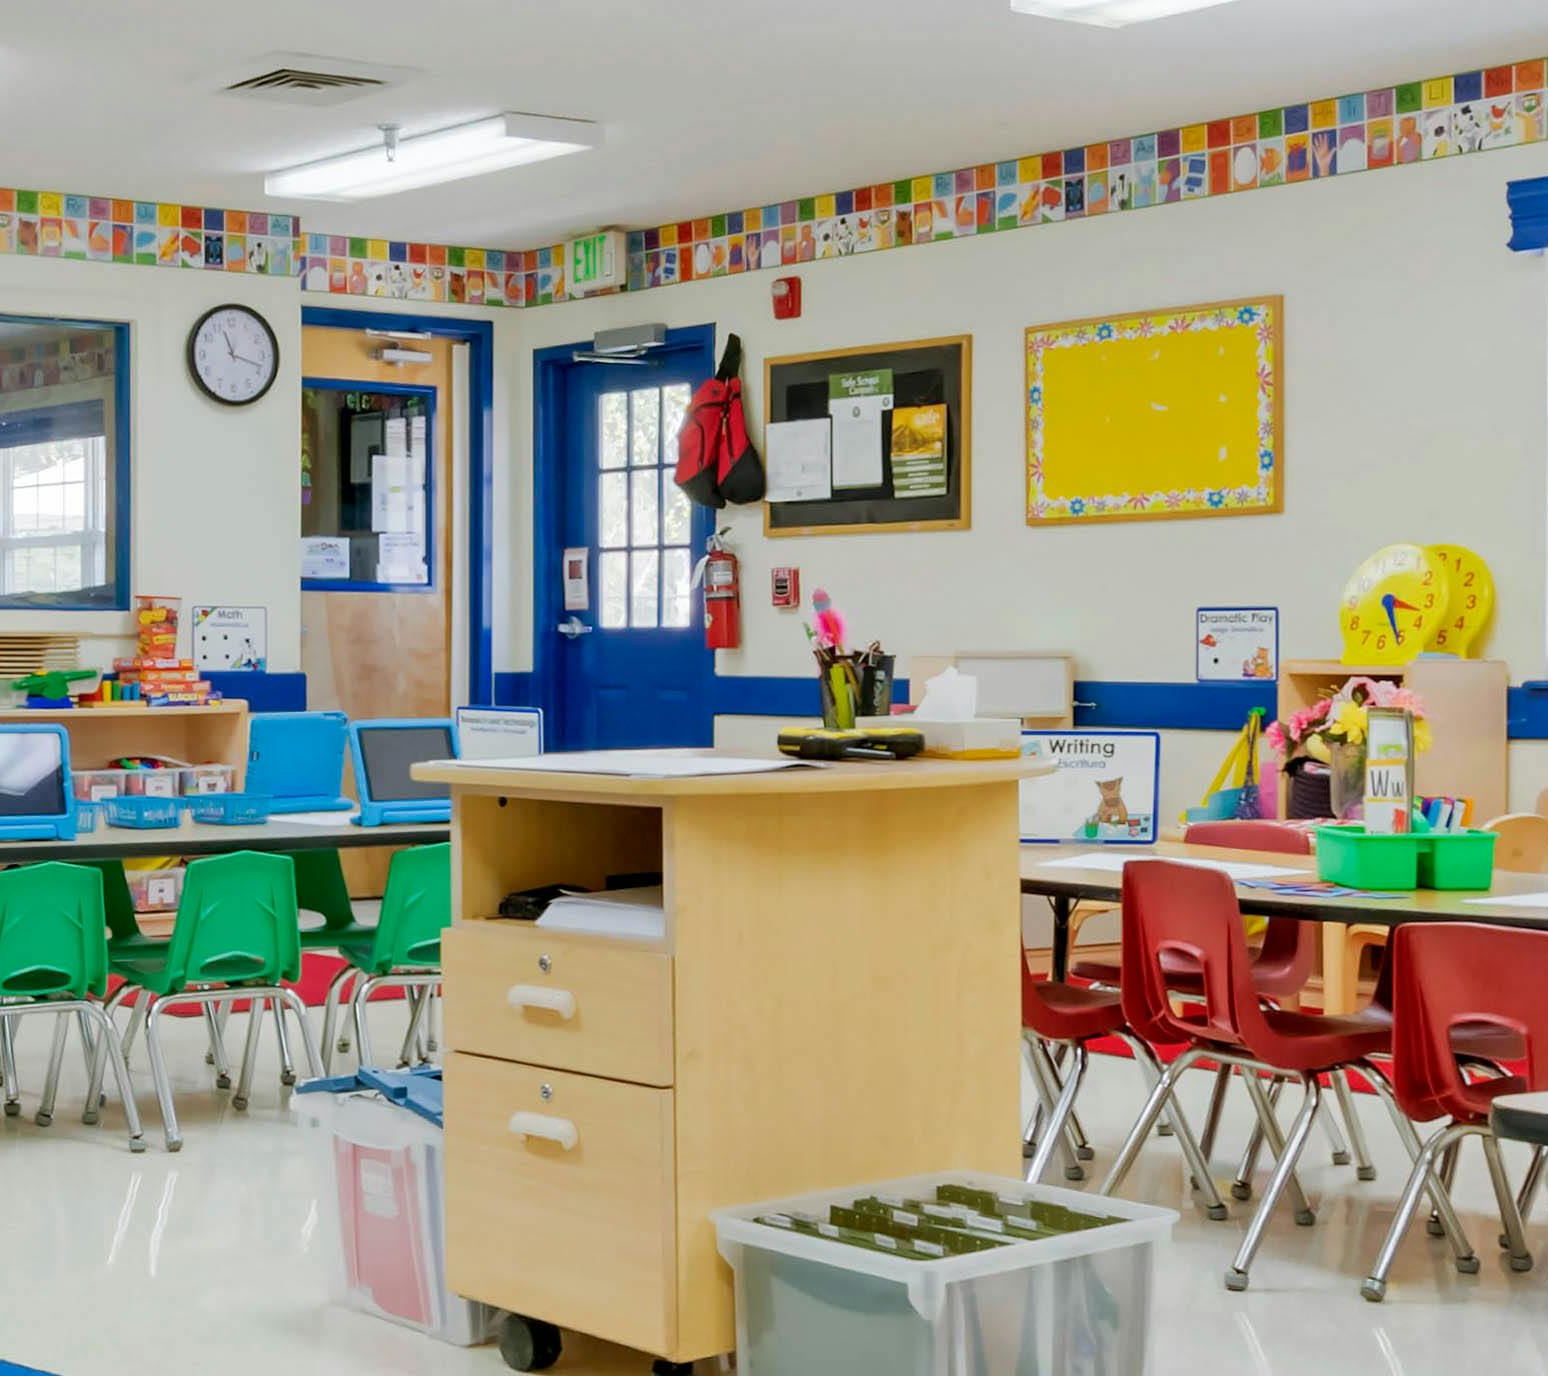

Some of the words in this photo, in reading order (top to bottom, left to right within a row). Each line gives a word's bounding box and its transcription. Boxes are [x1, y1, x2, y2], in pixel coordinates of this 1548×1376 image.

[573, 234, 607, 285] EXIT
[1455, 557, 1462, 572] 1
[1422, 570, 1433, 586] 2
[1464, 571, 1475, 587] 2
[1424, 593, 1435, 609] 3
[1466, 594, 1477, 610] 3
[1413, 615, 1423, 631] 4
[1454, 615, 1465, 630] 4
[1361, 630, 1371, 645] 7
[1376, 634, 1386, 650] 6
[1436, 629, 1448, 645] 5
[1049, 739, 1115, 758] Writing
[1370, 769, 1404, 797] Ww
